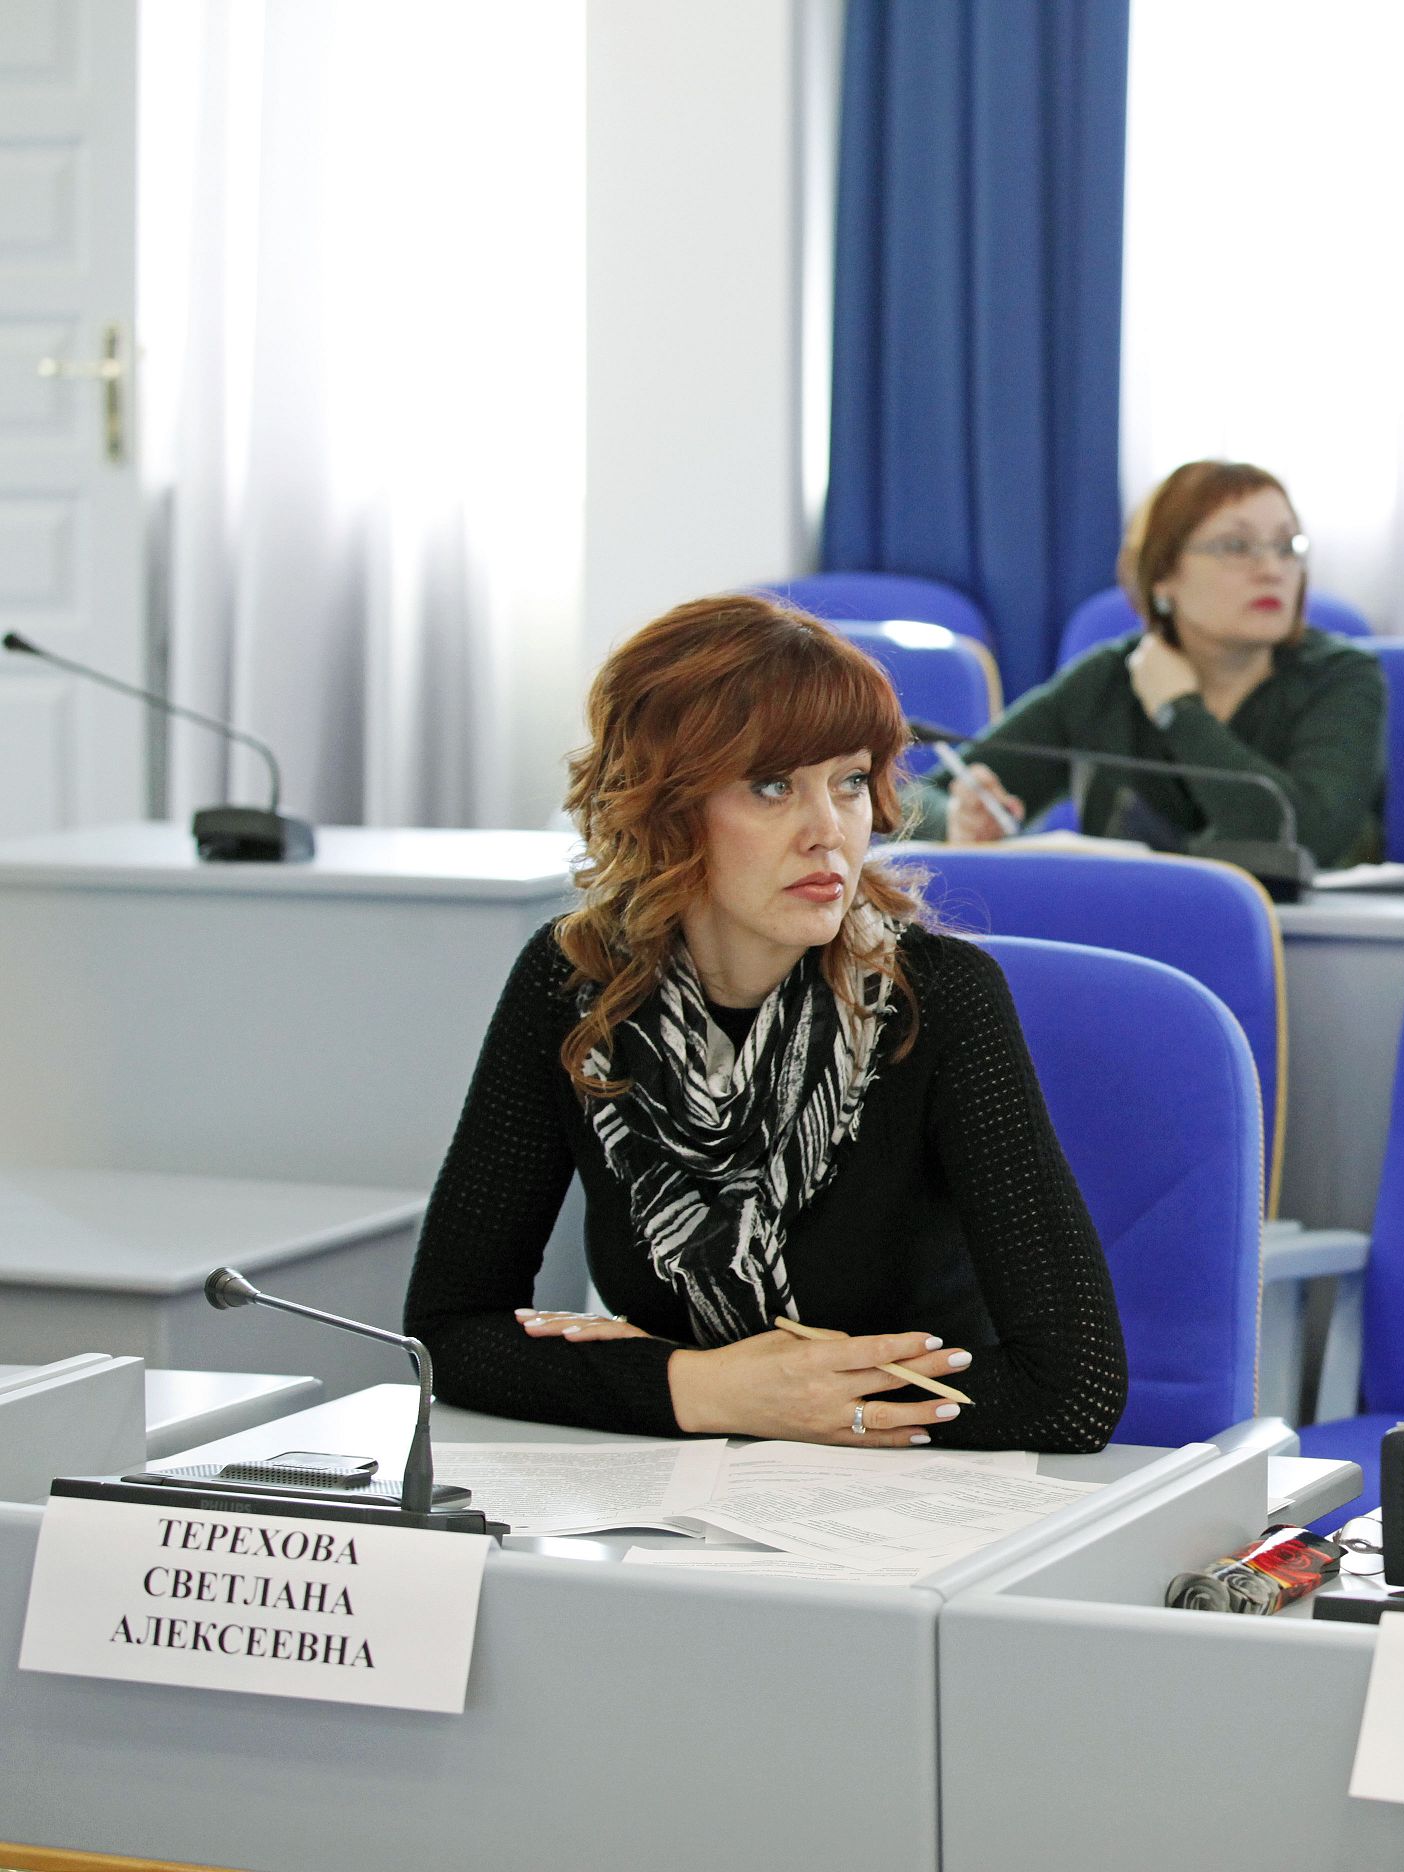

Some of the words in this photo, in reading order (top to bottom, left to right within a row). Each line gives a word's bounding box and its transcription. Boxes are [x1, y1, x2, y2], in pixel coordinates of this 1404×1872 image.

[159, 1518, 359, 1565] ТЕРЕХОВА
[144, 1565, 354, 1615] СВЕТЛАНА
[110, 1614, 375, 1668] АЛЕКСЕЕВНА
